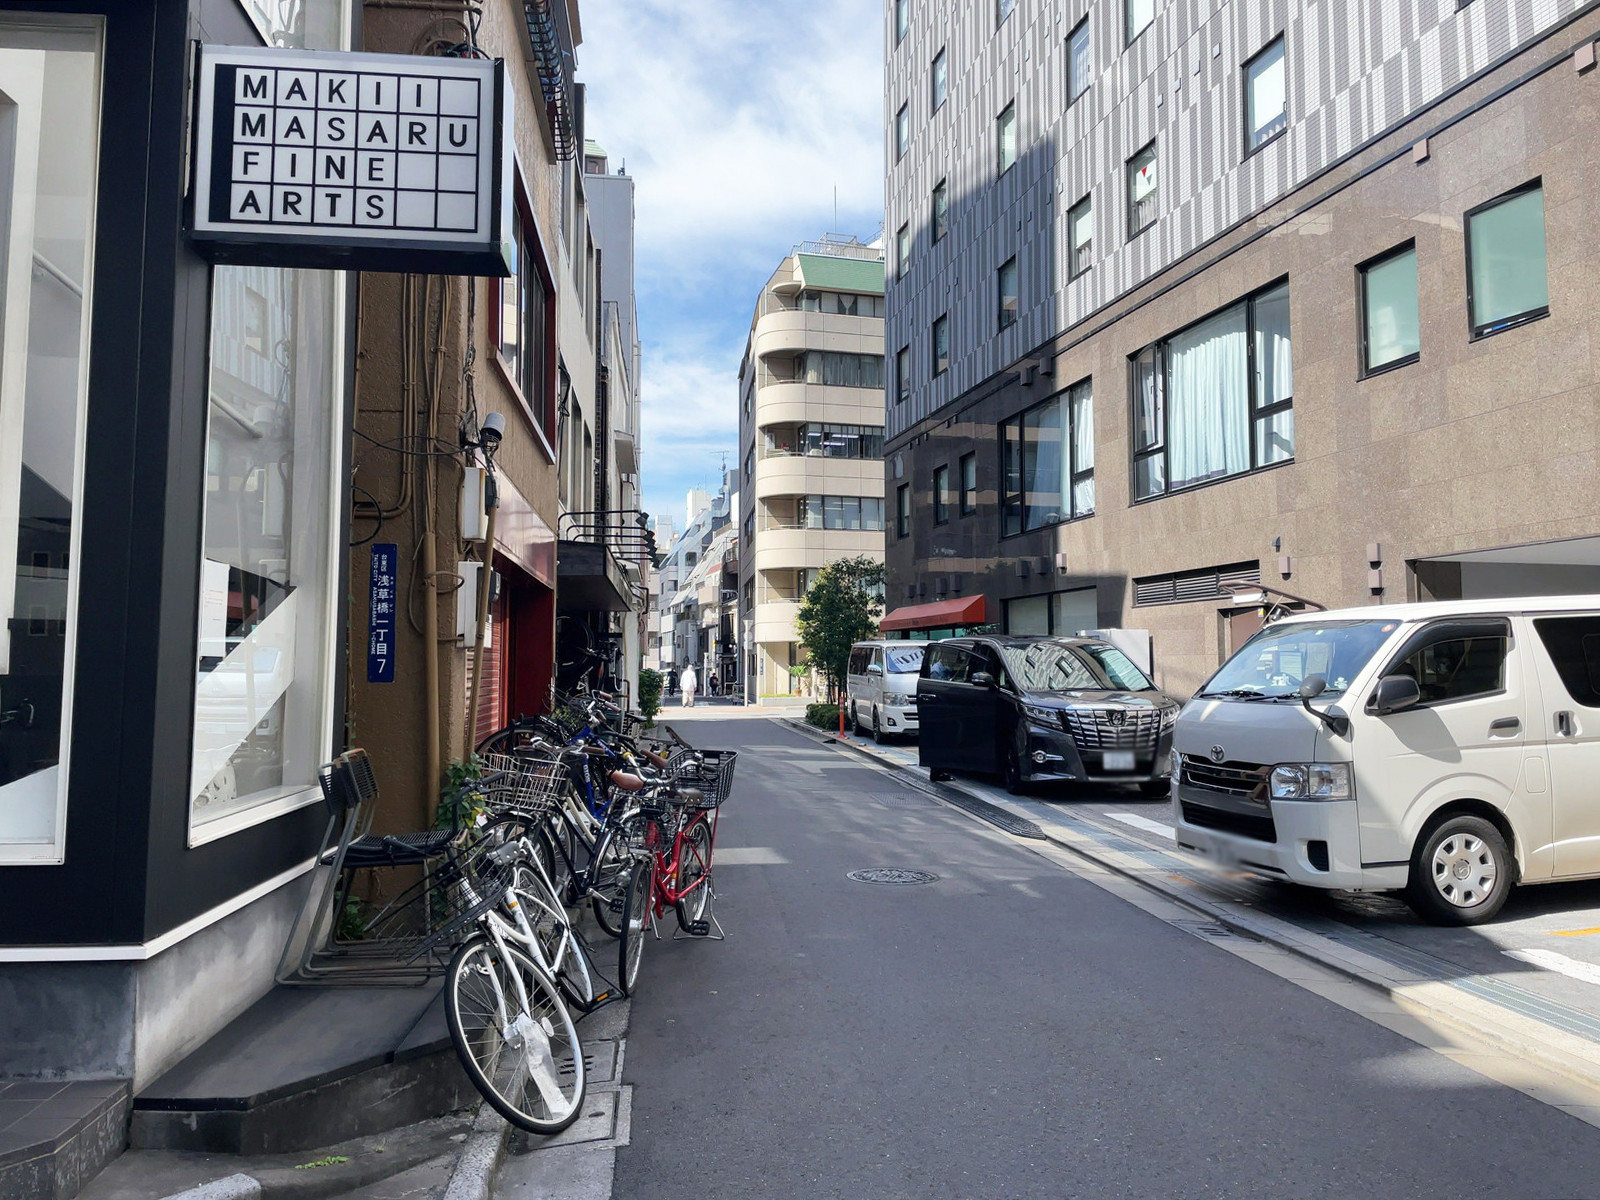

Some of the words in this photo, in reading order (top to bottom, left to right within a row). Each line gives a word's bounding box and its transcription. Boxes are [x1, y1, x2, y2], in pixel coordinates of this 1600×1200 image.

[243, 74, 422, 108] MAKII
[241, 113, 468, 147] MASARU
[243, 151, 385, 182] FINE
[239, 190, 385, 219] ARTS
